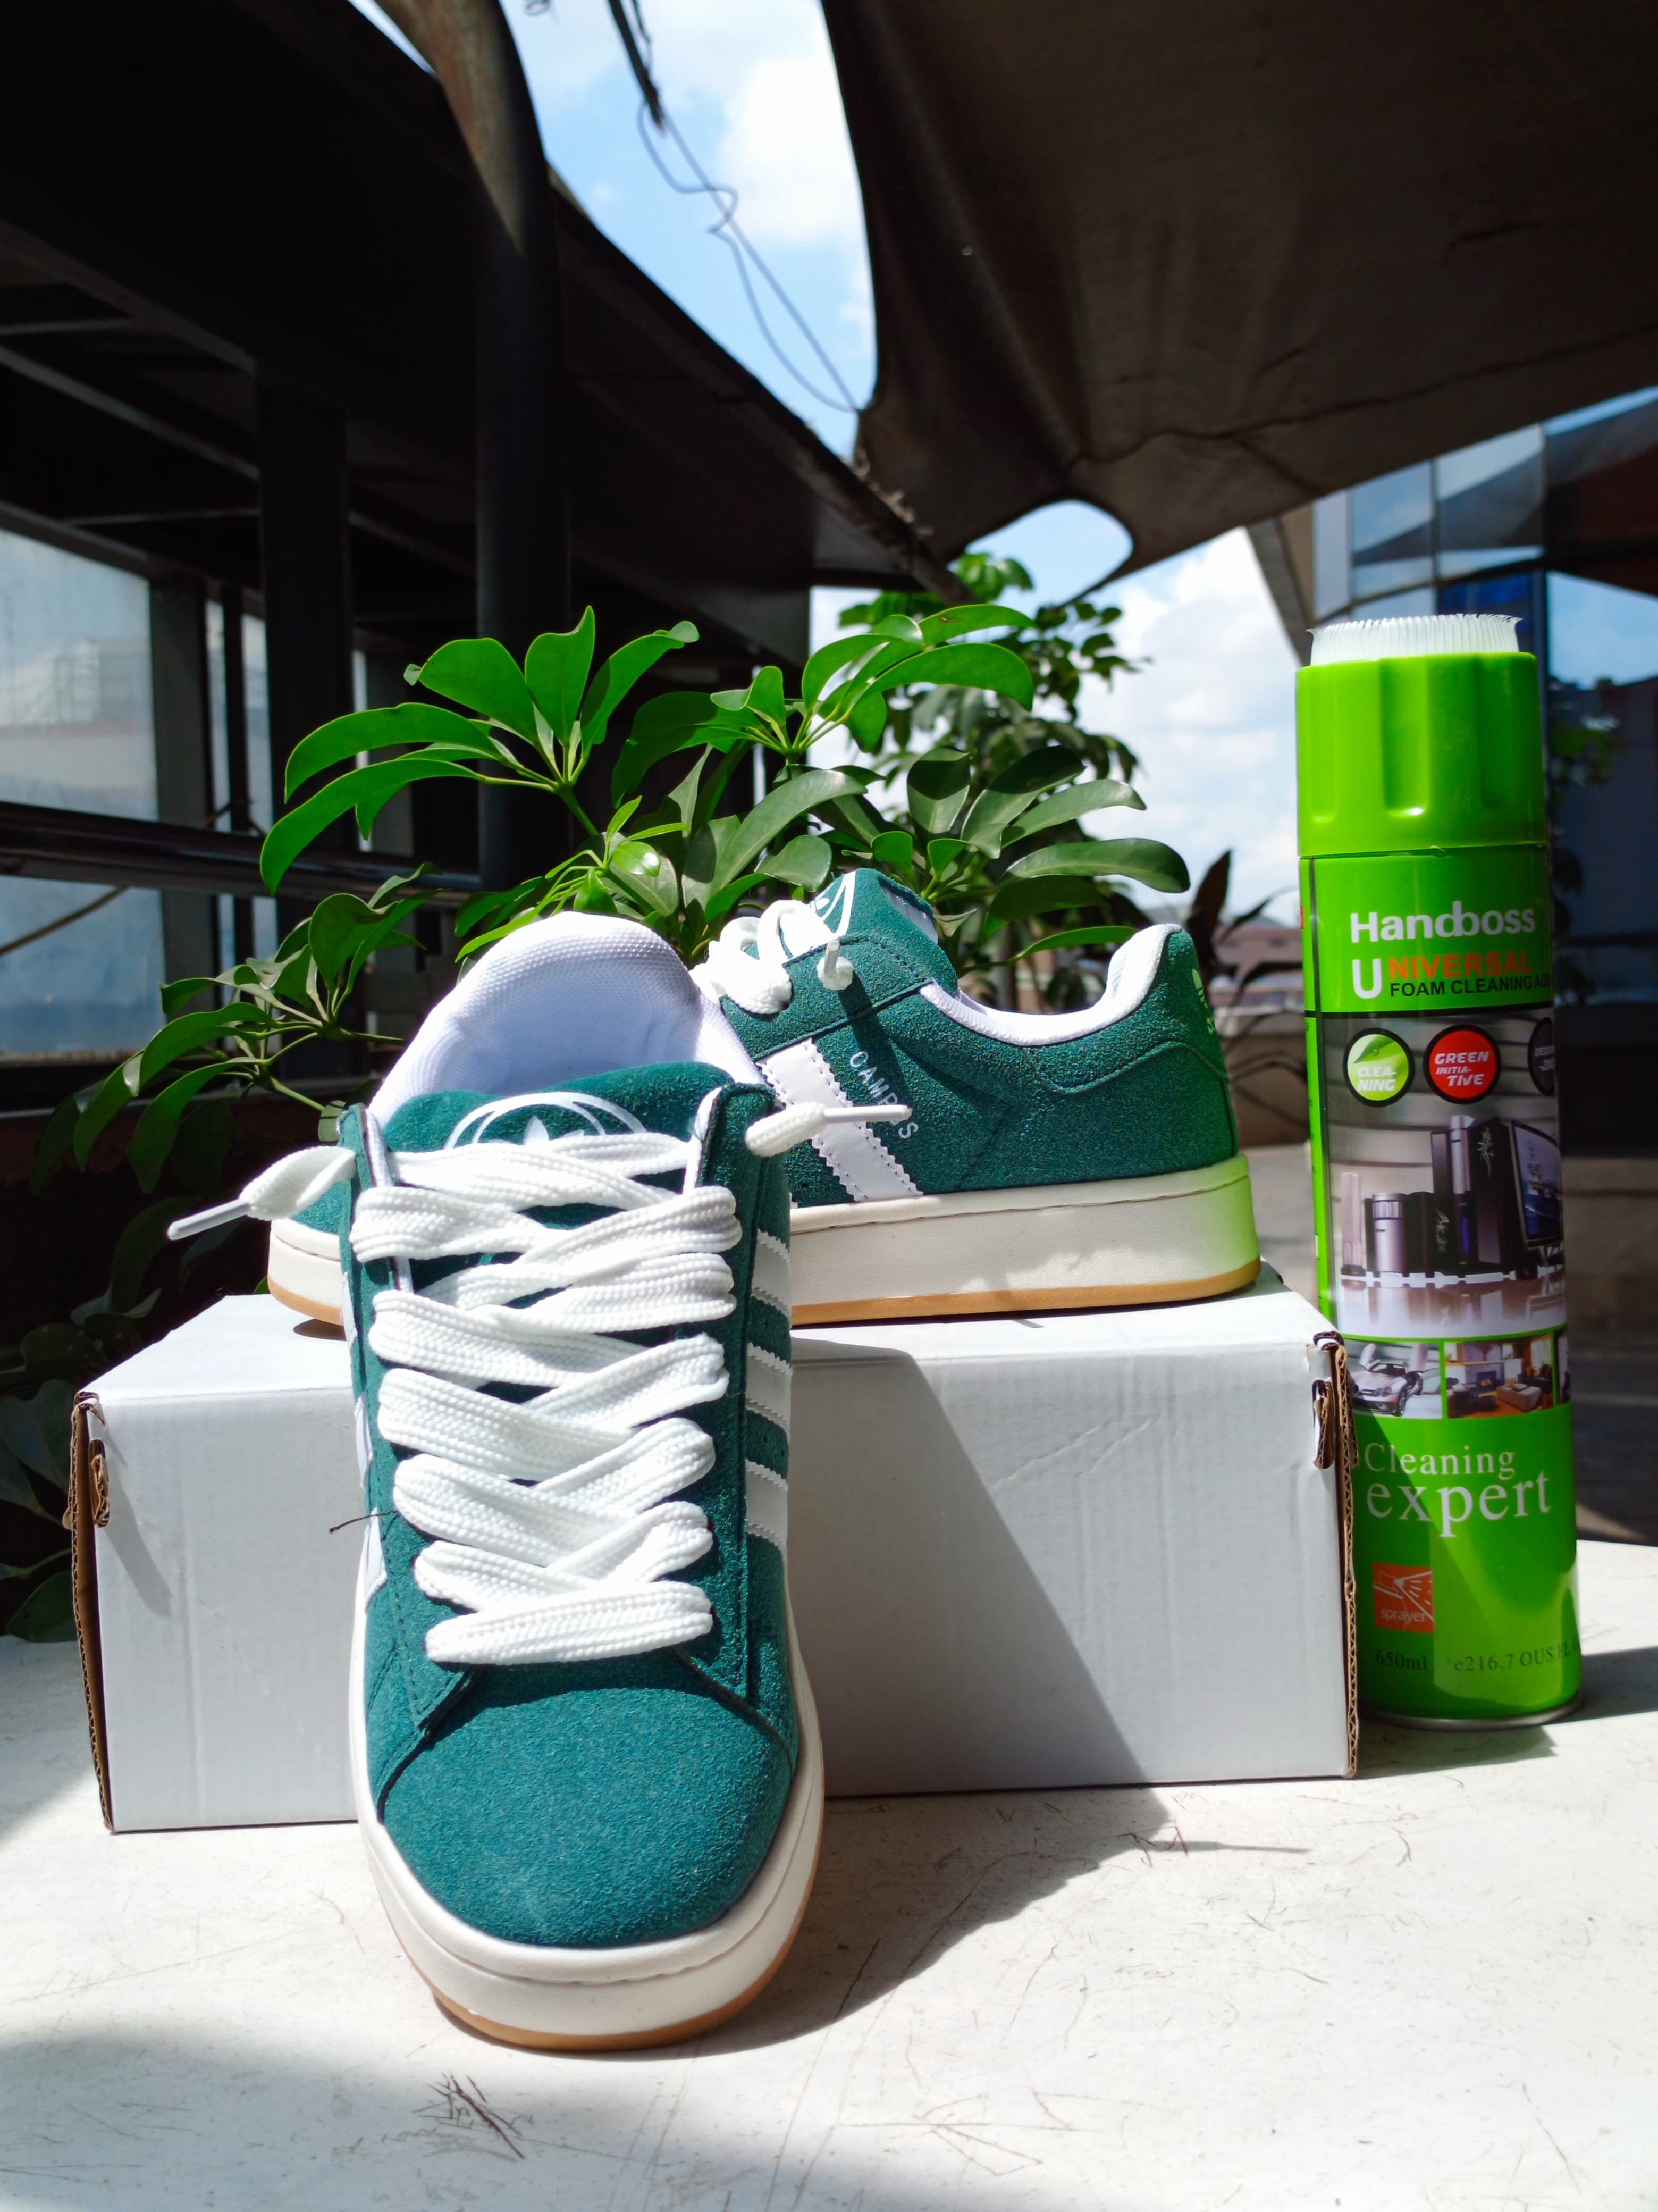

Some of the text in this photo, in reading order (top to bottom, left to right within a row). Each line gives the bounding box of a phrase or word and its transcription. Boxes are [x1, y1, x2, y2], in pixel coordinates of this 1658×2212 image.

[1350, 901, 1536, 943] Handboss
[1390, 981, 1445, 997] FOAM
[1451, 975, 1533, 993] CLEANING
[1435, 1051, 1489, 1065] GREEN
[849, 1051, 919, 1139] CAMPS
[1357, 1079, 1396, 1091] NING
[1364, 1442, 1515, 1481] Cleaning
[1366, 1470, 1551, 1538] expert
[1380, 1608, 1427, 1625] sprayer
[1376, 1650, 1428, 1670] 650ml
